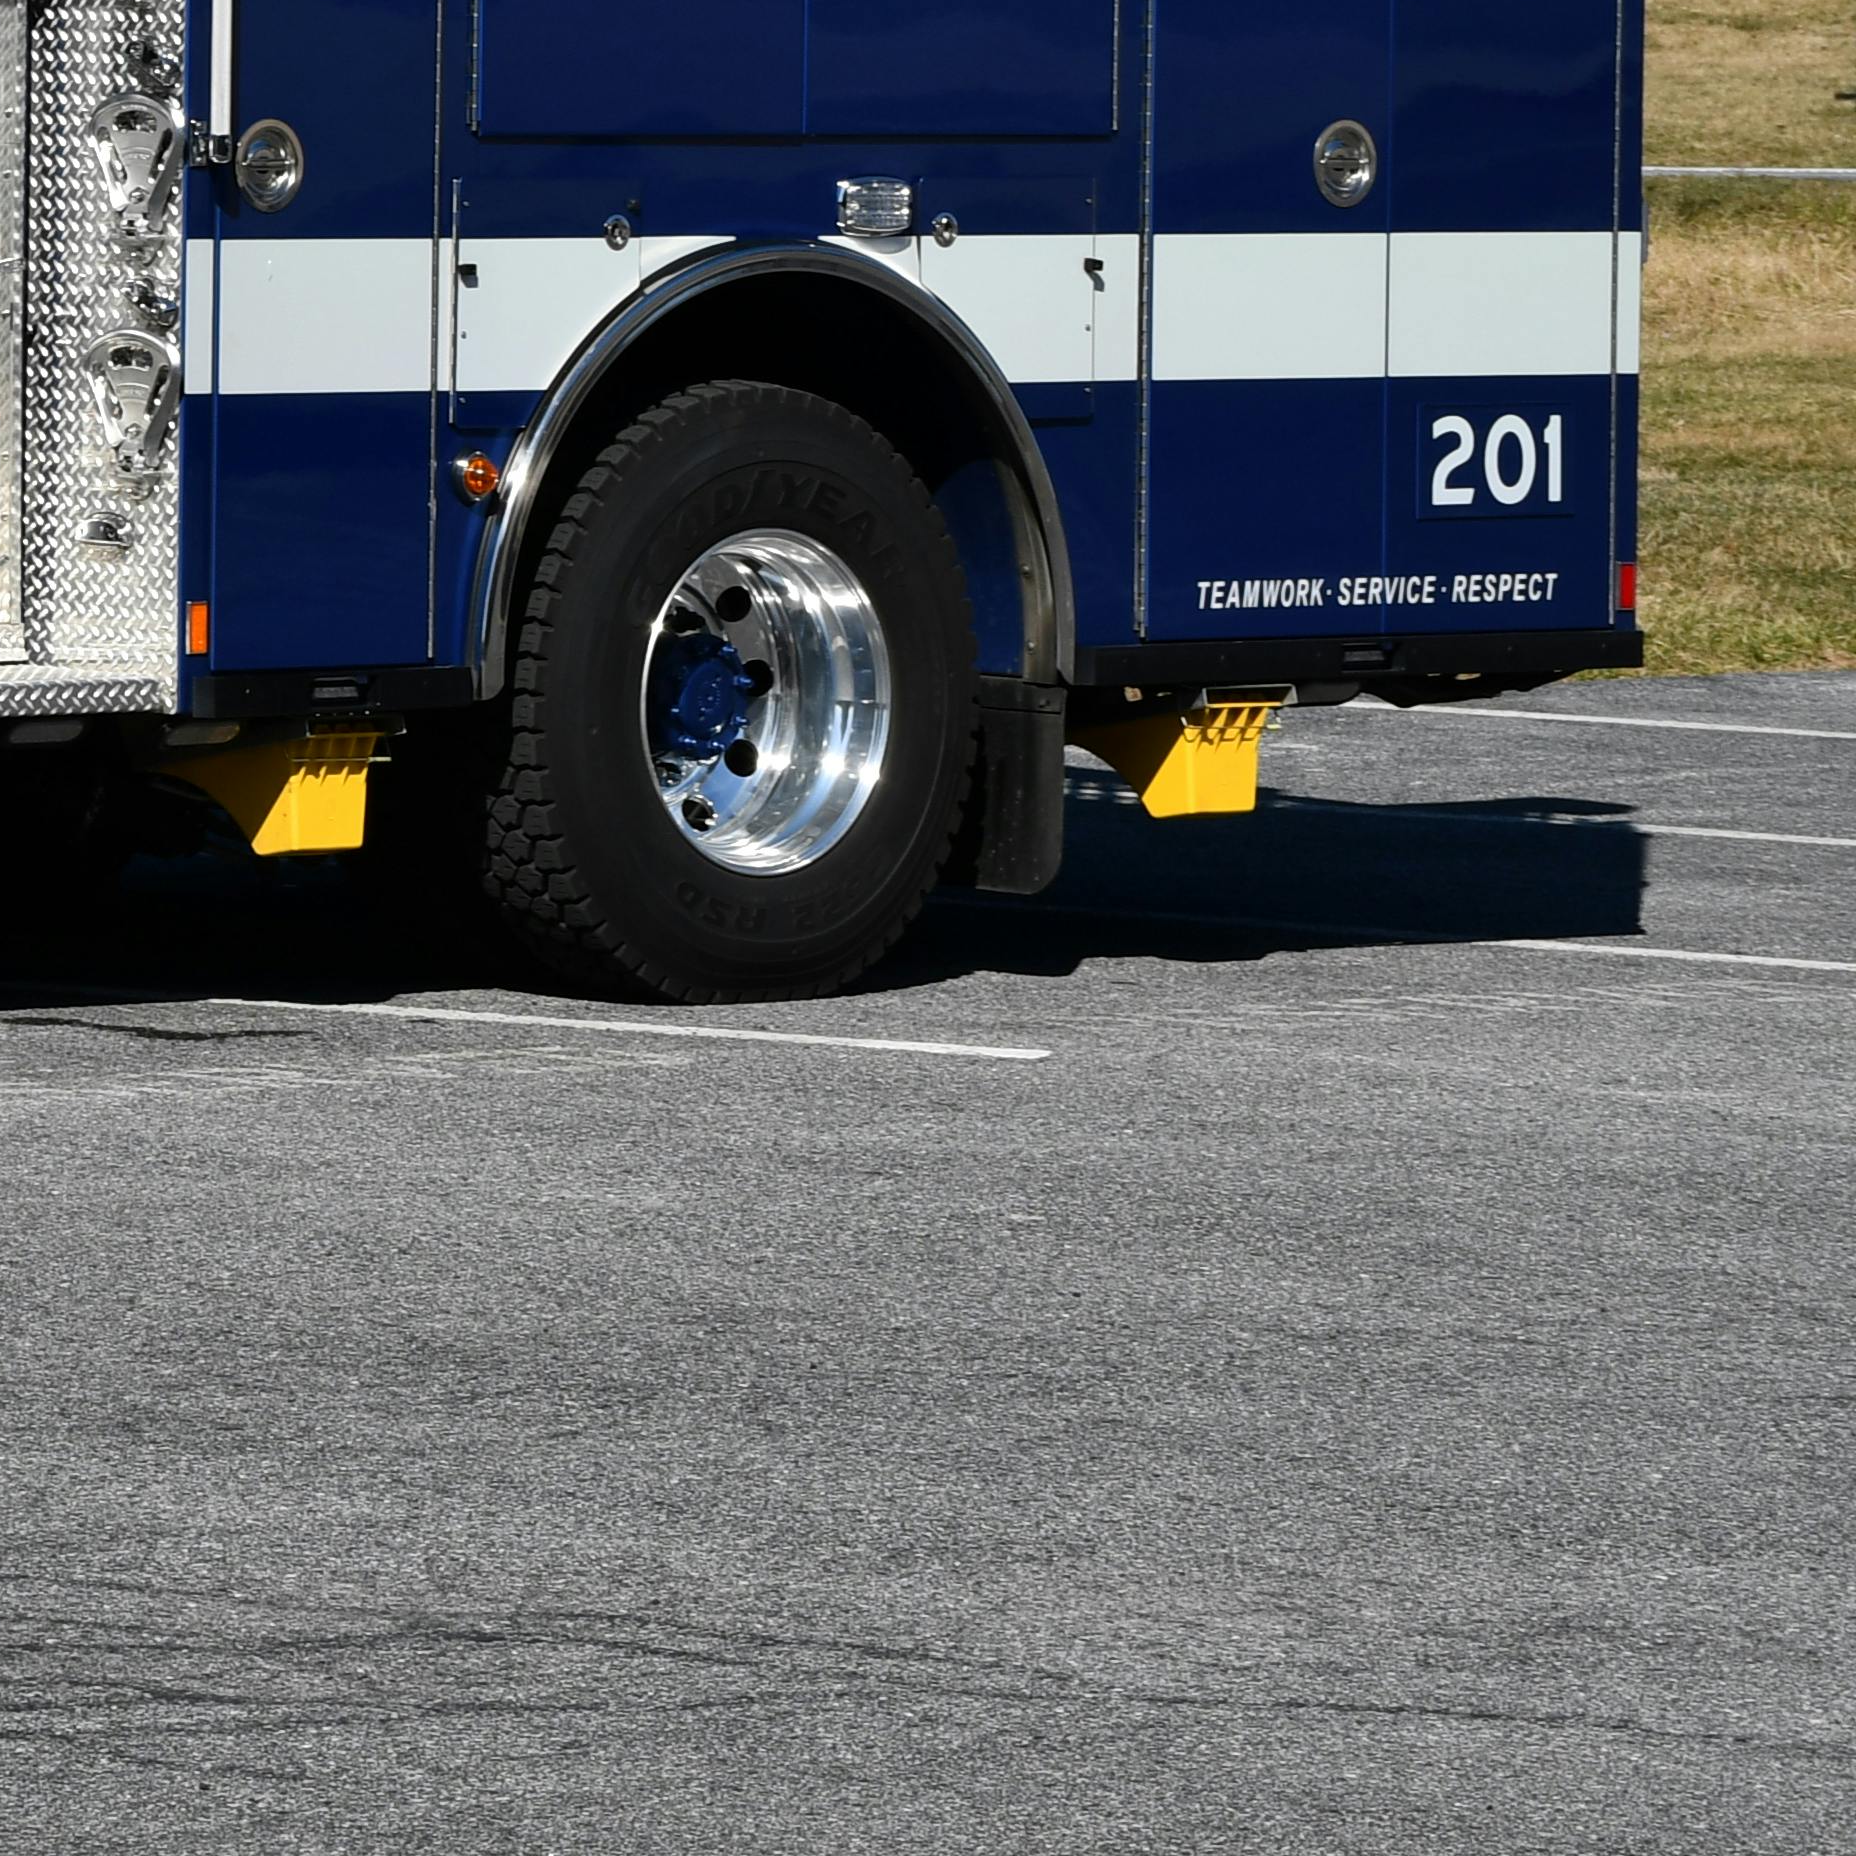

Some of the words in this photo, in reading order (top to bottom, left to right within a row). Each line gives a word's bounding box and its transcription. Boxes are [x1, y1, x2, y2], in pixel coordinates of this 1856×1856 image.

[1431, 414, 1562, 506] 201
[1197, 578, 1325, 610] TEAMWORK
[1337, 575, 1437, 606] SERVICE
[1451, 572, 1558, 603] RESPECT
